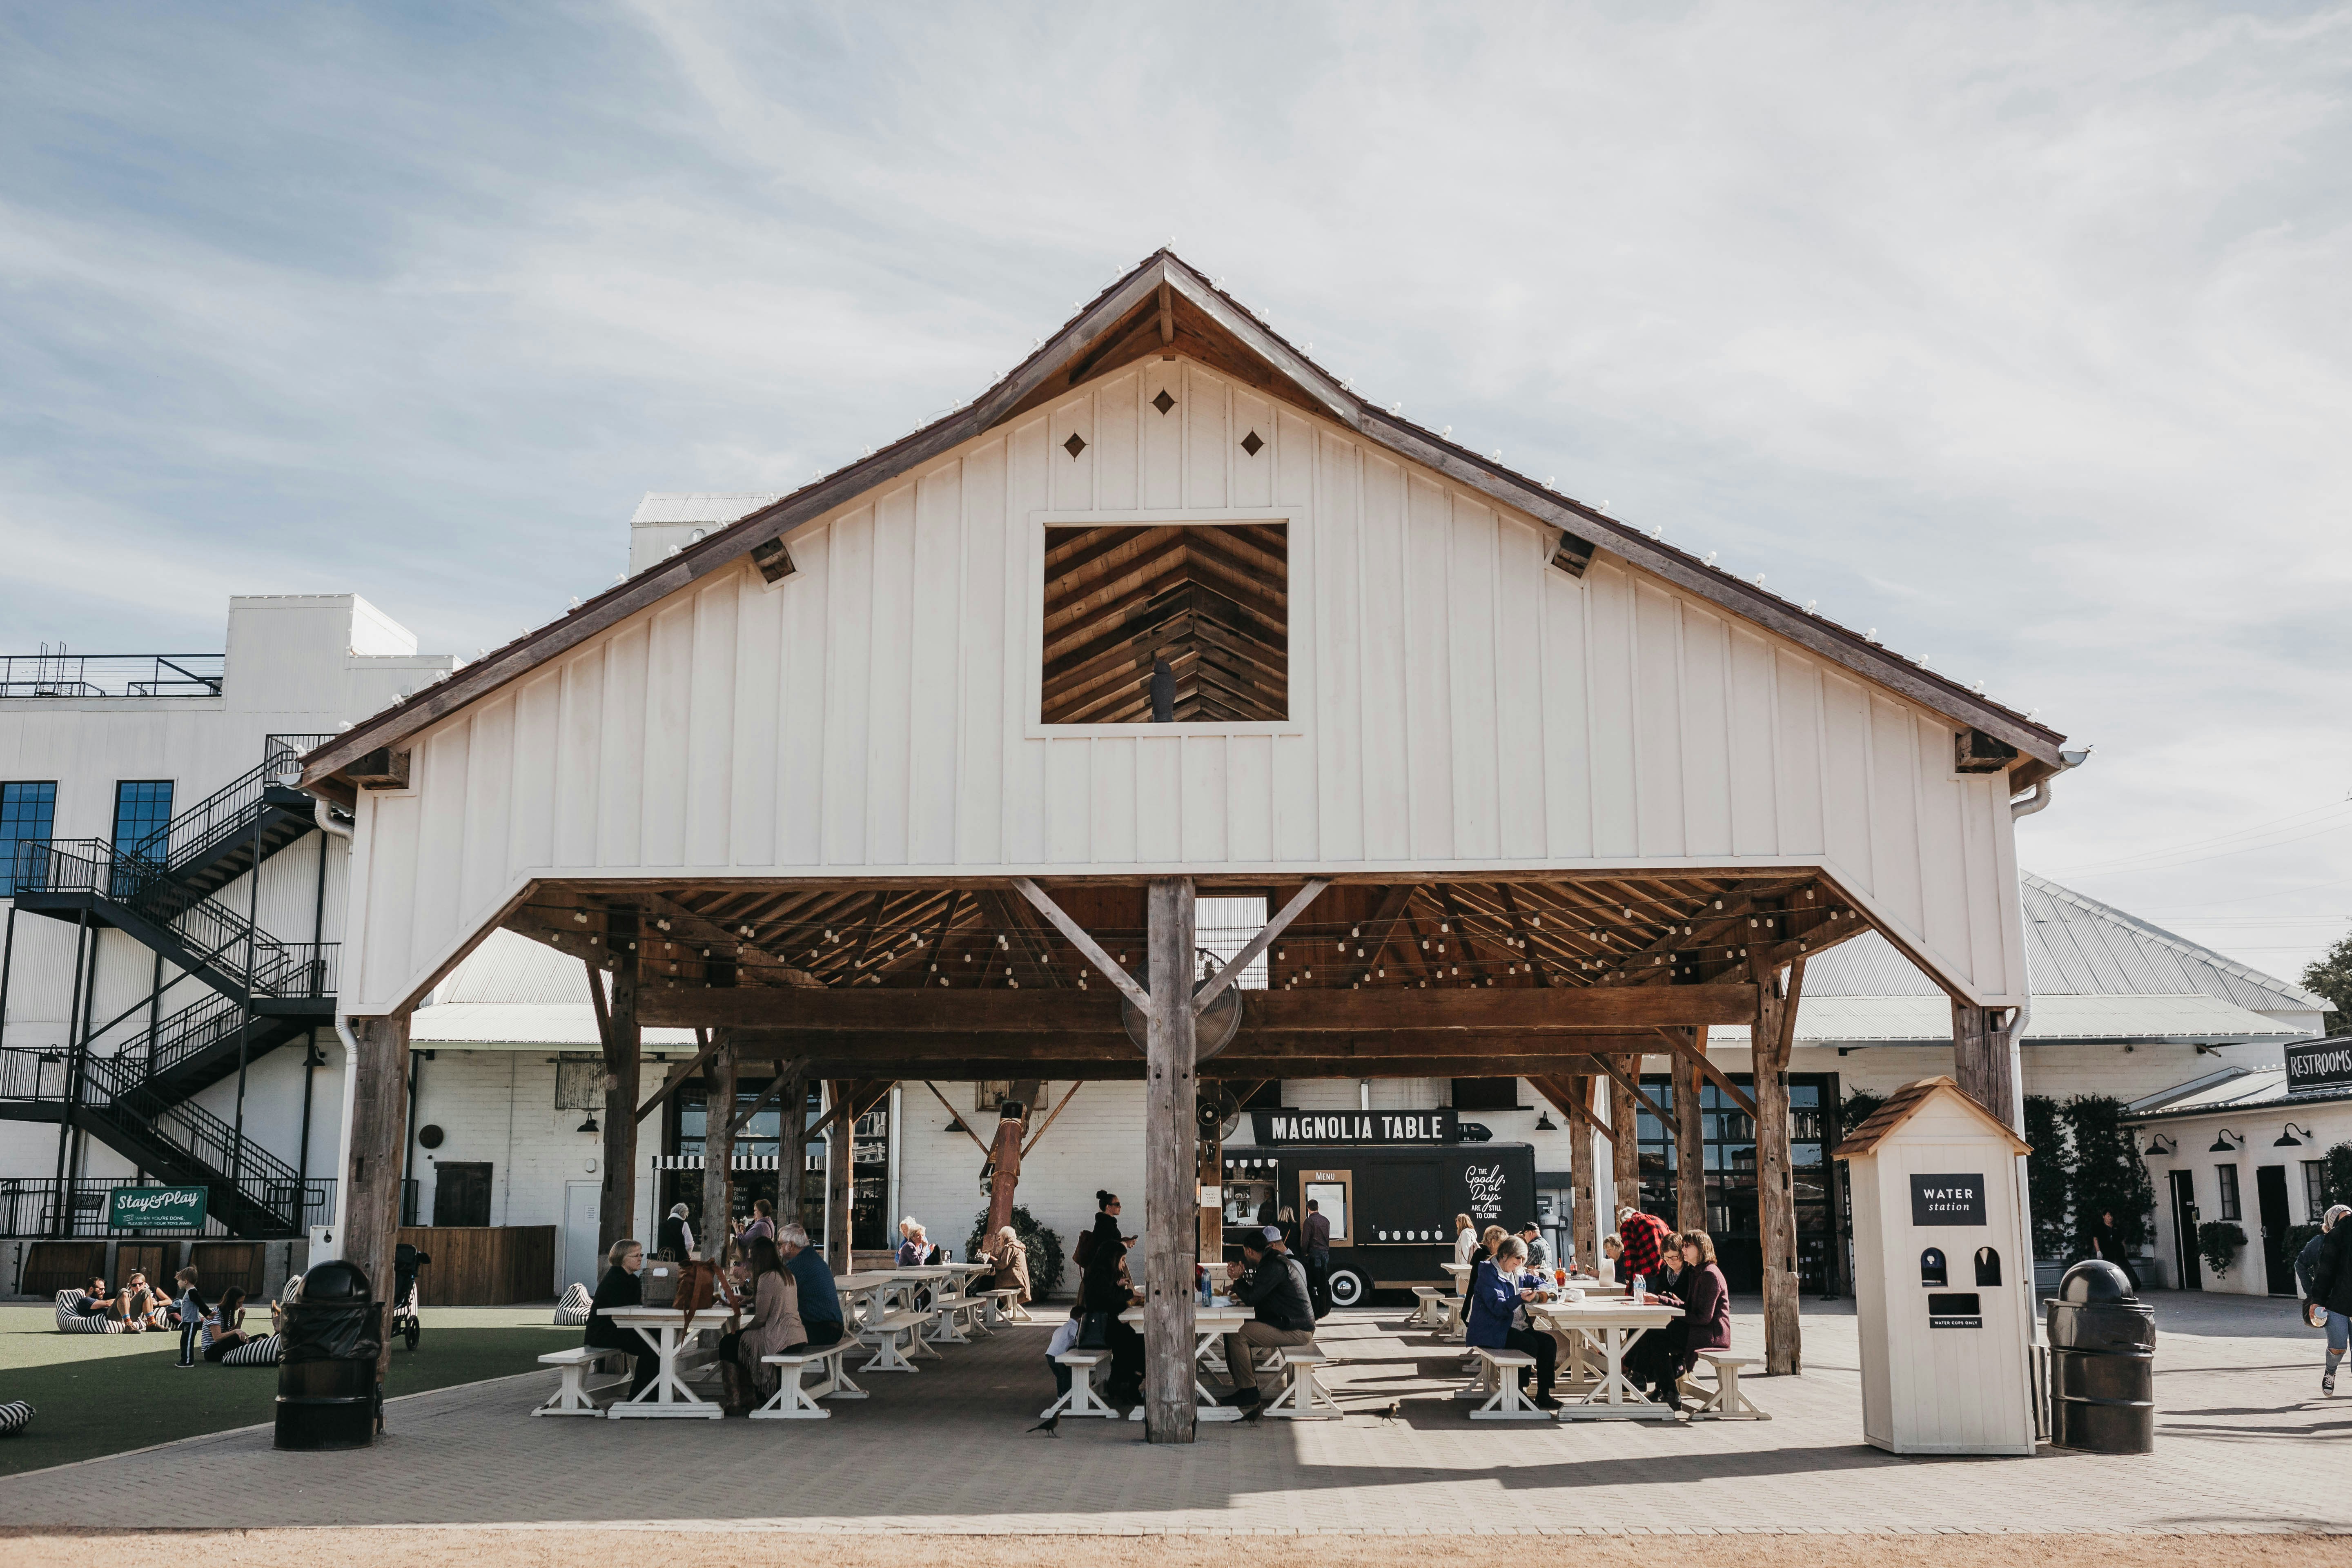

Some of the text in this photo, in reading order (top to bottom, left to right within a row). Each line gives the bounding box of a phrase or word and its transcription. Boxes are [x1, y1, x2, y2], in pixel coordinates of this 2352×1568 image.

[2290, 1049, 2352, 1078] RESTROOMS
[1272, 1116, 1442, 1139] MAGNOLIA TABLE
[1316, 1172, 1335, 1180] MENU
[1465, 1165, 1499, 1189] Good
[1471, 1183, 1501, 1212] Days
[1923, 1189, 1973, 1199] WATER
[1929, 1202, 1969, 1211] station
